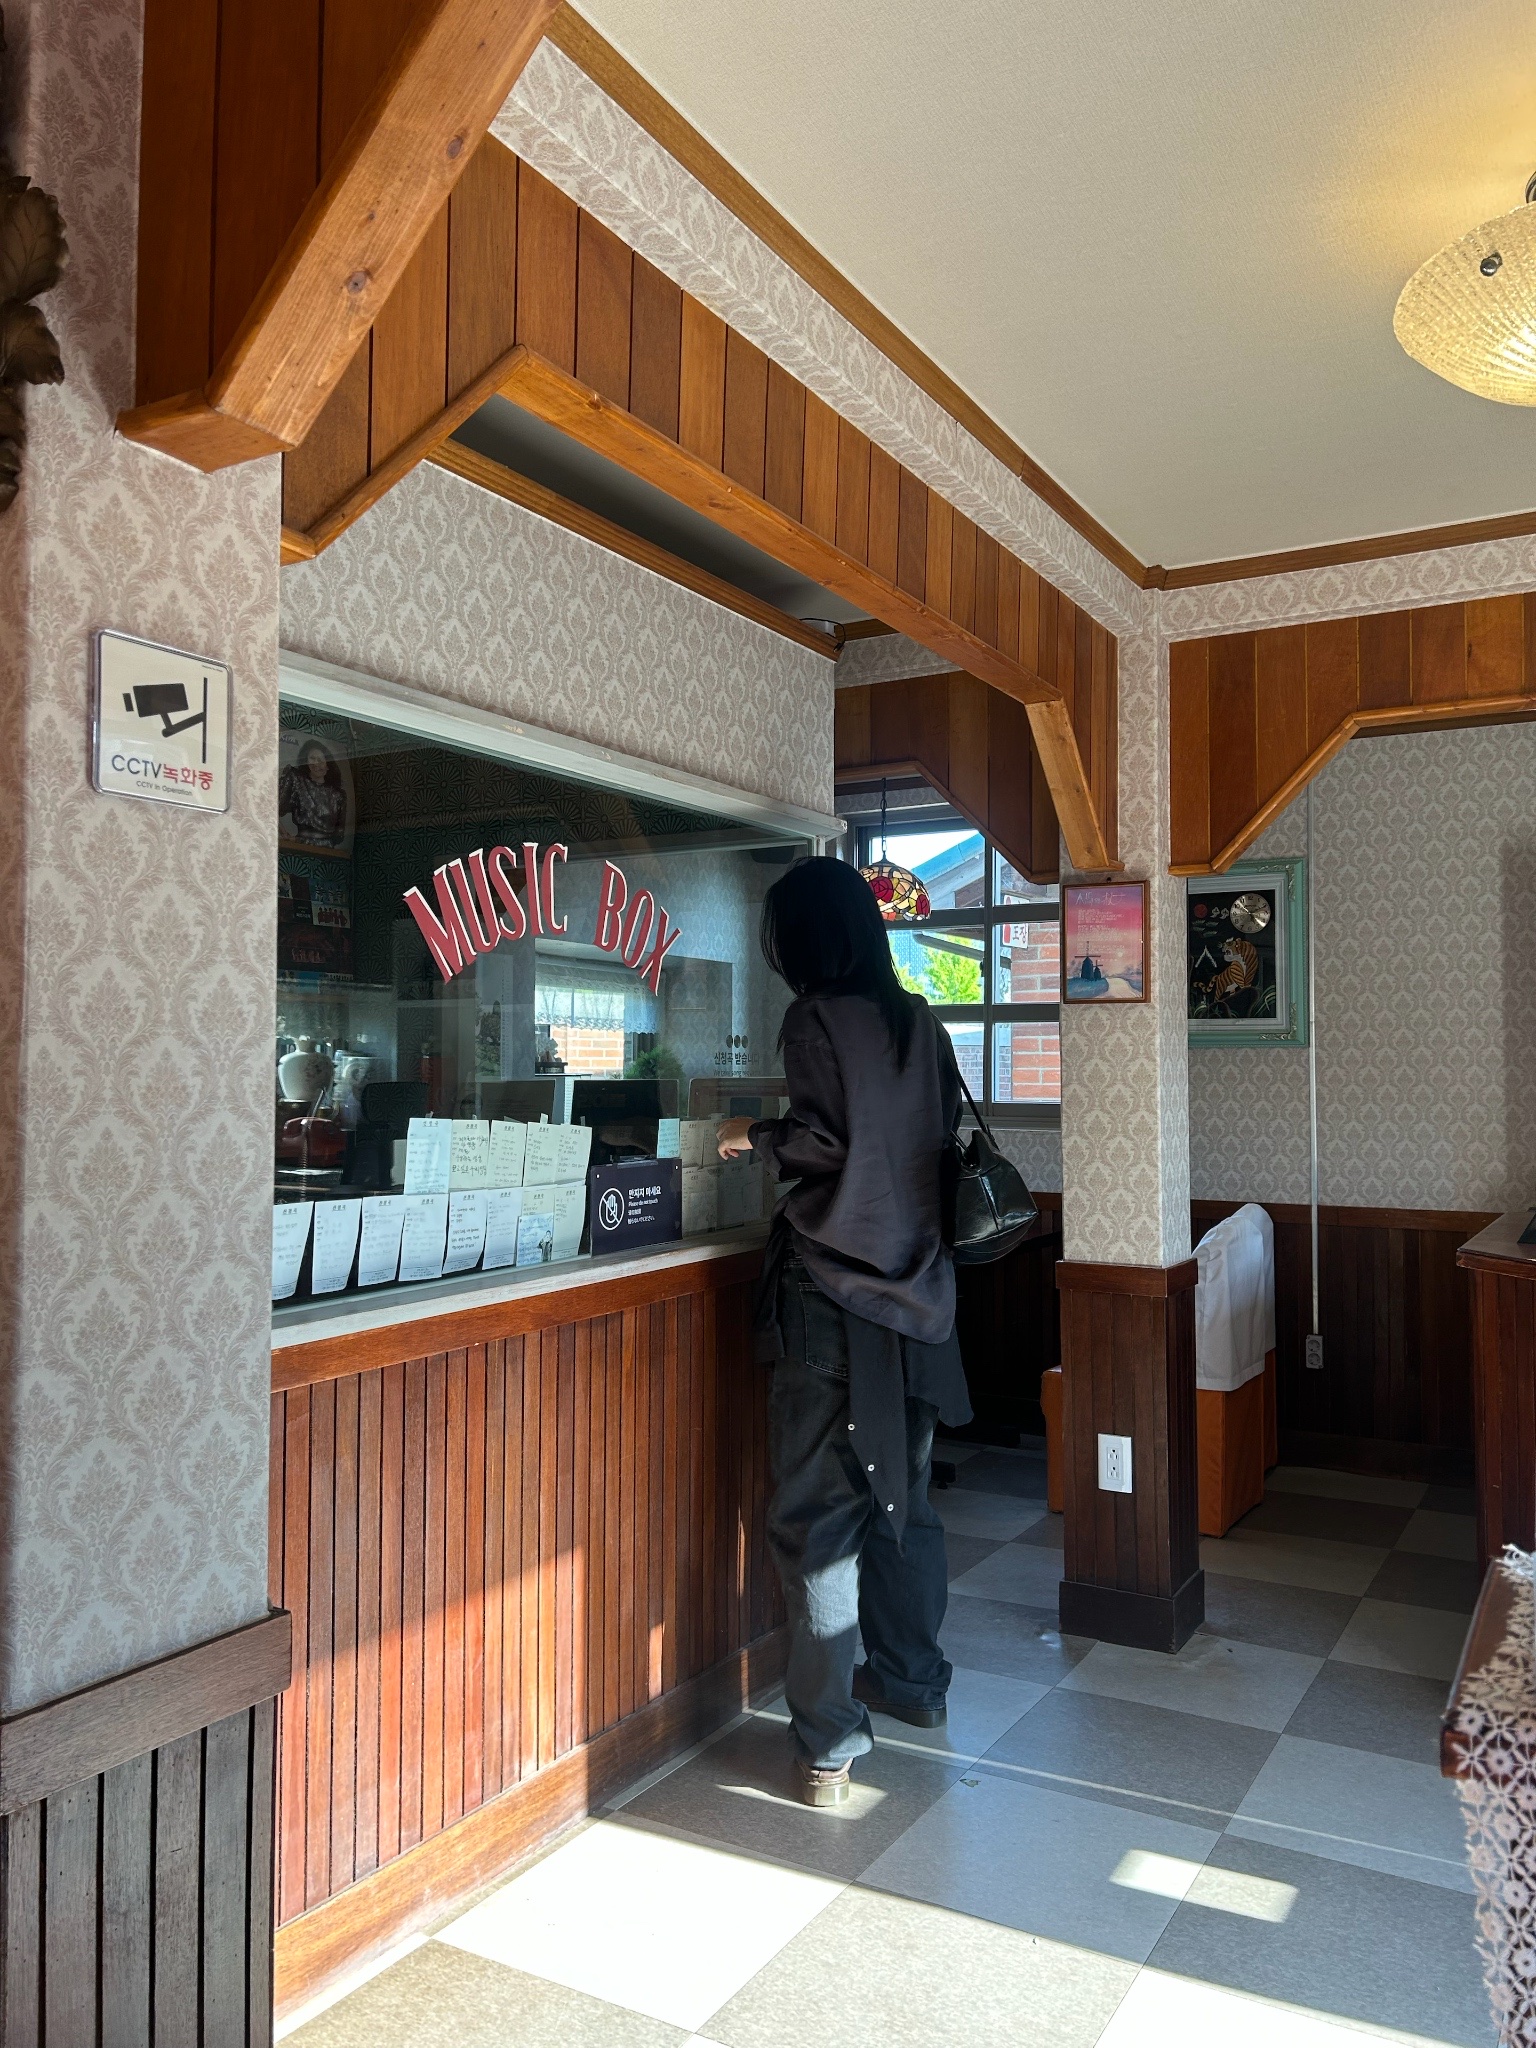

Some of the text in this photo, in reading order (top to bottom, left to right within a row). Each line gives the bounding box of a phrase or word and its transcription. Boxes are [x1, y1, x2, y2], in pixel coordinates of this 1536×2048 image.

[136, 780, 154, 789] CCTV
[161, 785, 194, 796] Operation
[402, 842, 683, 997] MUSIC BOX
[714, 1051, 760, 1066] 신청곡 받습니다
[629, 1185, 661, 1199] 만지지 마세요
